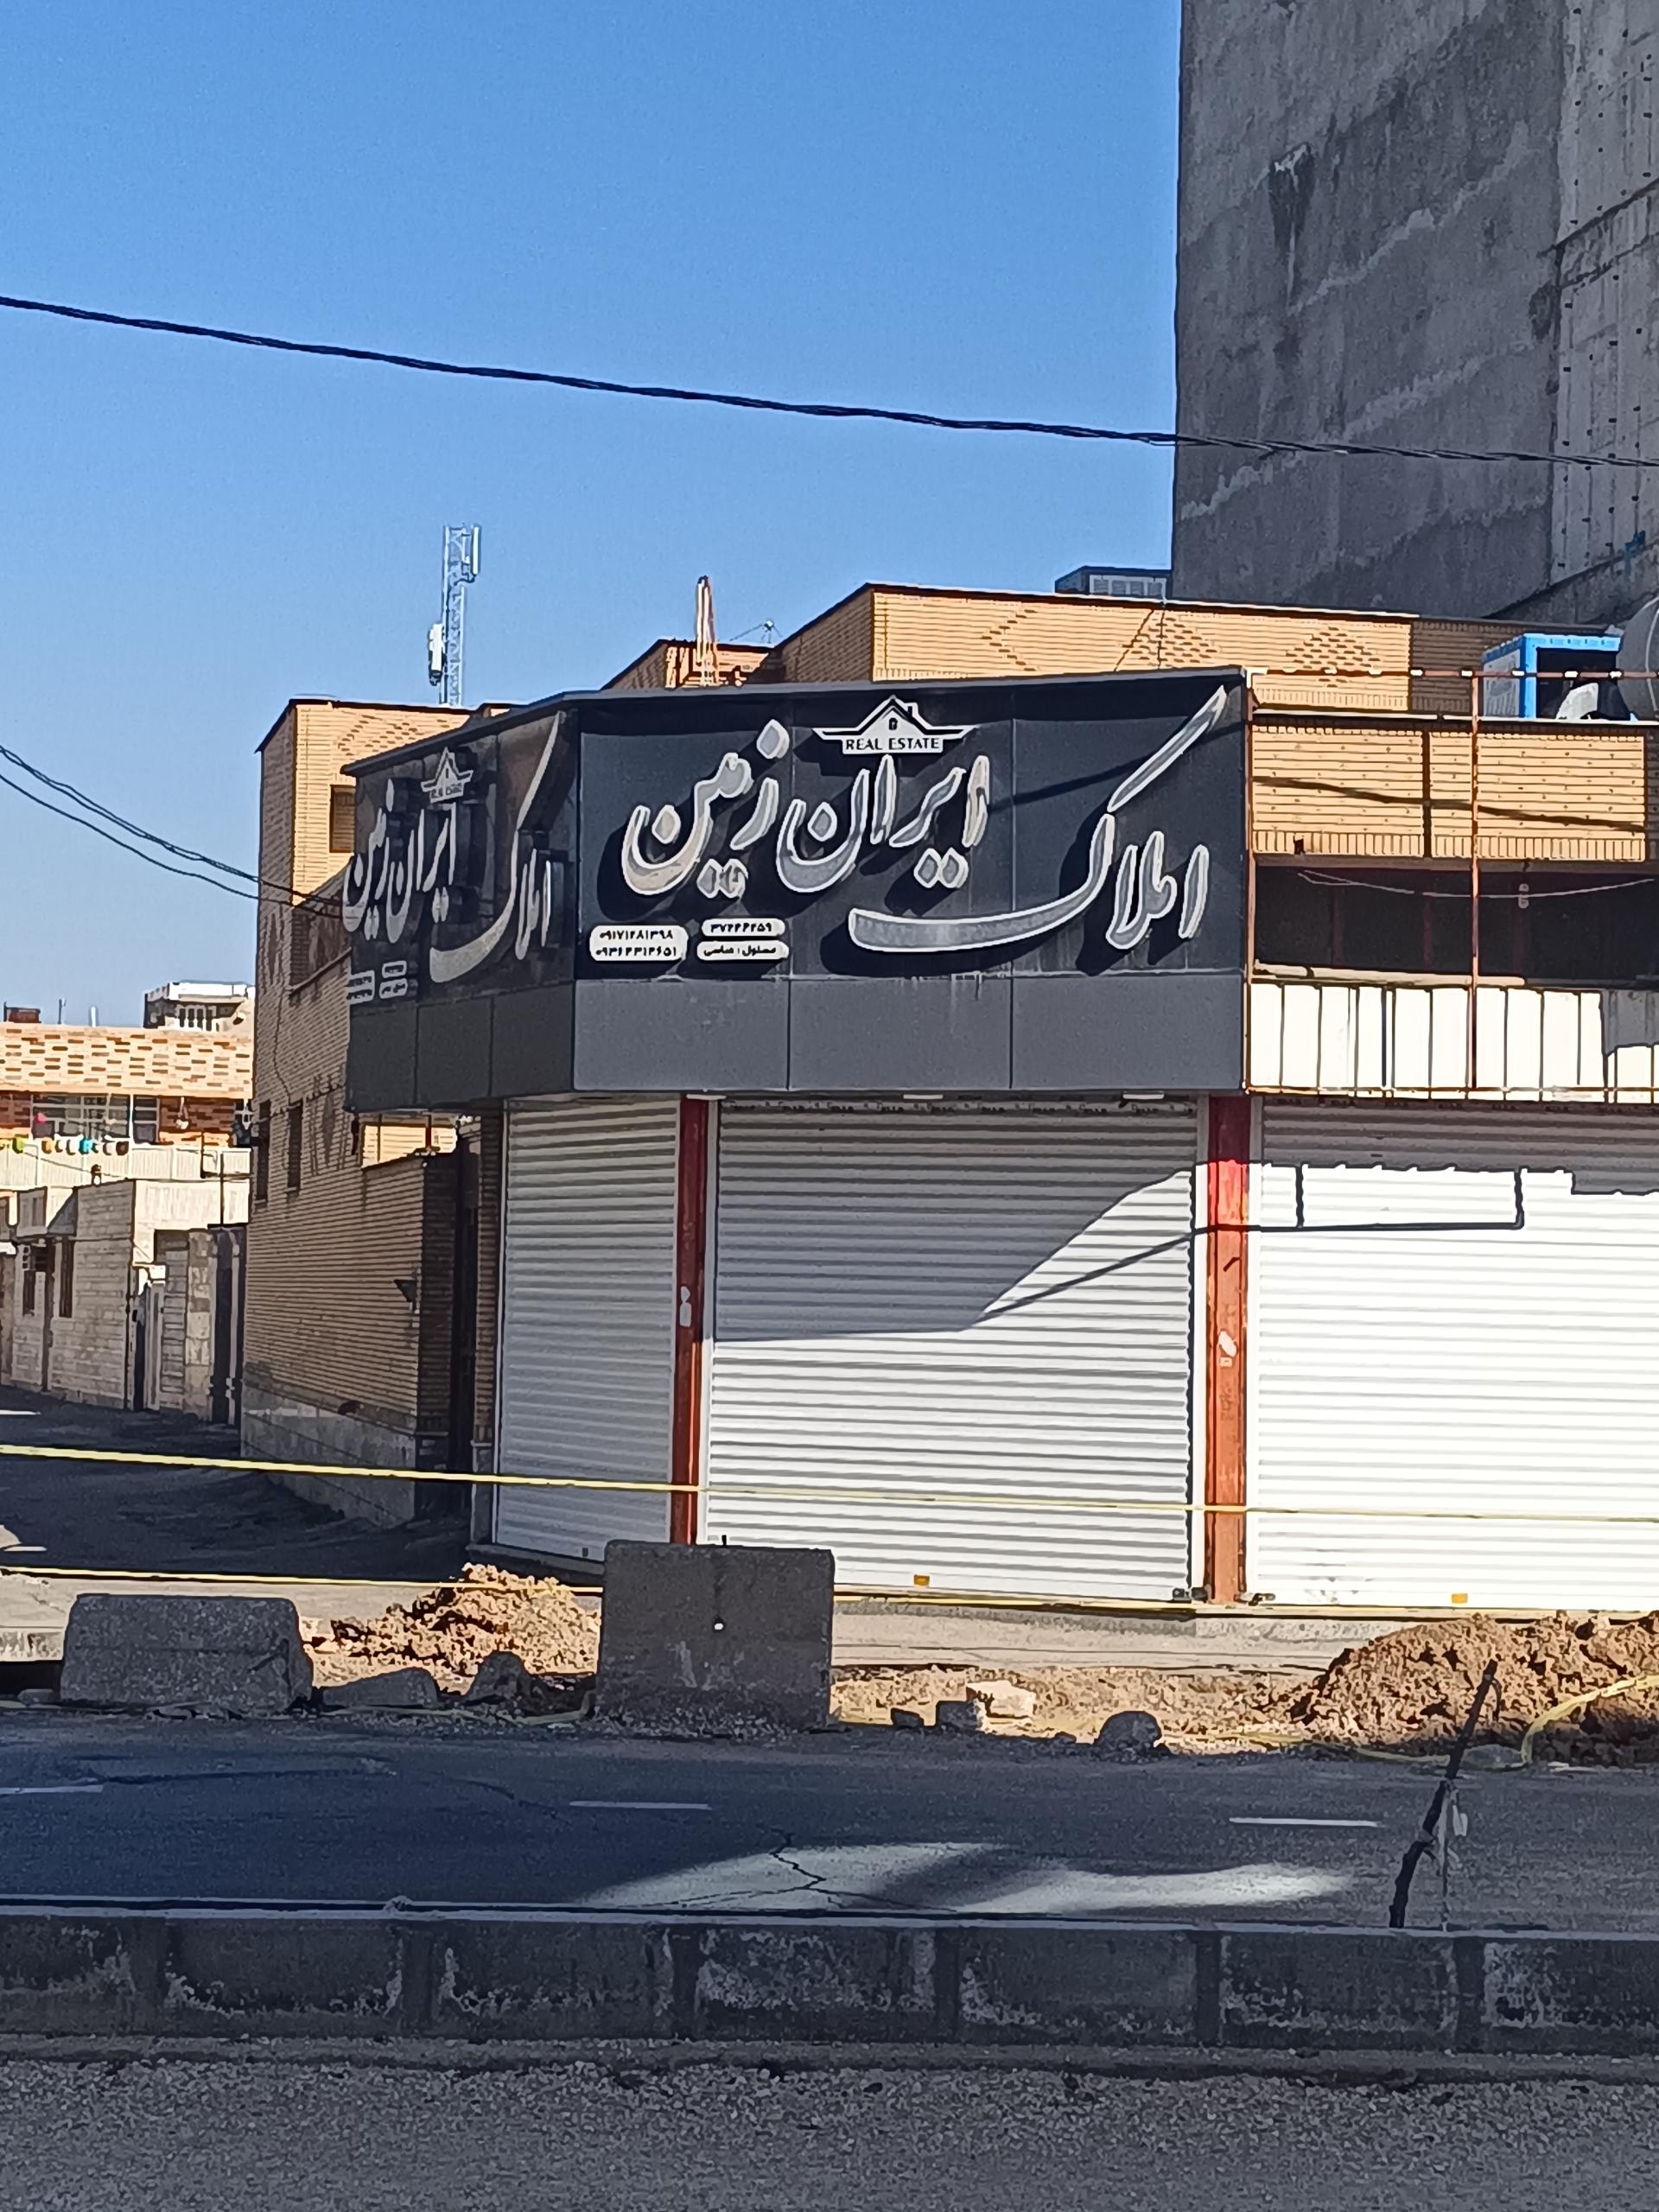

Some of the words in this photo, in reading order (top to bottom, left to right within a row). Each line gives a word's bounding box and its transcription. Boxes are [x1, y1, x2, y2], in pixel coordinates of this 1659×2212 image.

[621, 718, 790, 899] زمین
[776, 754, 990, 893] ایران
[845, 738, 883, 751] REAL
[888, 737, 940, 750] ESTATE
[849, 685, 1226, 952] املاک
